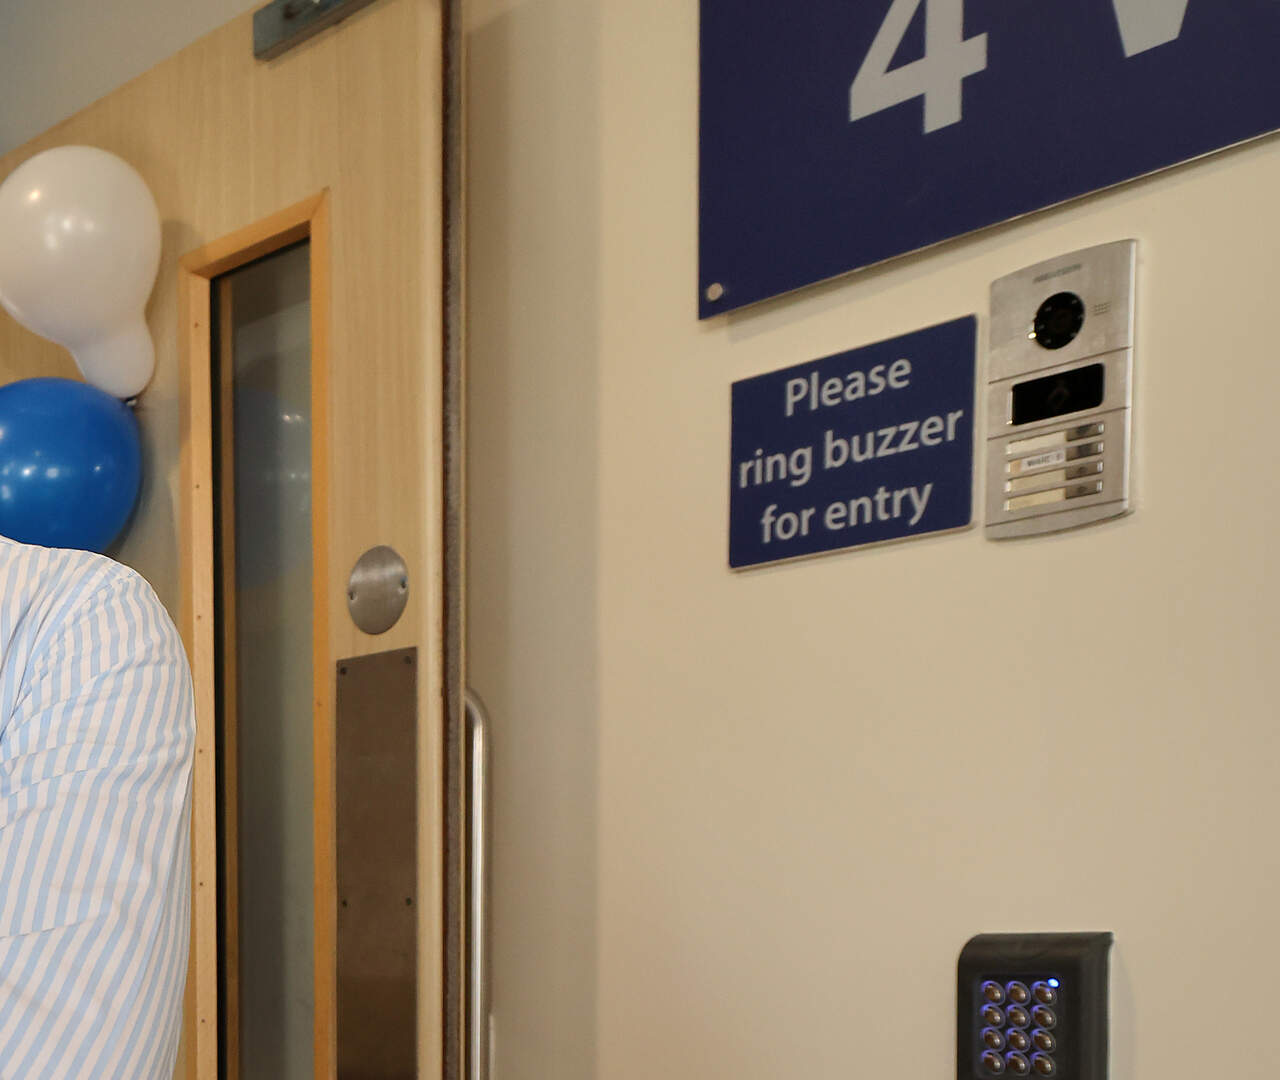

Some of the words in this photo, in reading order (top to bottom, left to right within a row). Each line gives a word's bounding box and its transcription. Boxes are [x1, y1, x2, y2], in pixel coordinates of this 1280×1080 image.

[849, 0, 988, 134] 4
[784, 358, 912, 417] Please
[739, 446, 813, 488] ring
[823, 409, 963, 470] buzzer
[760, 504, 815, 543] for
[824, 482, 933, 531] entry
